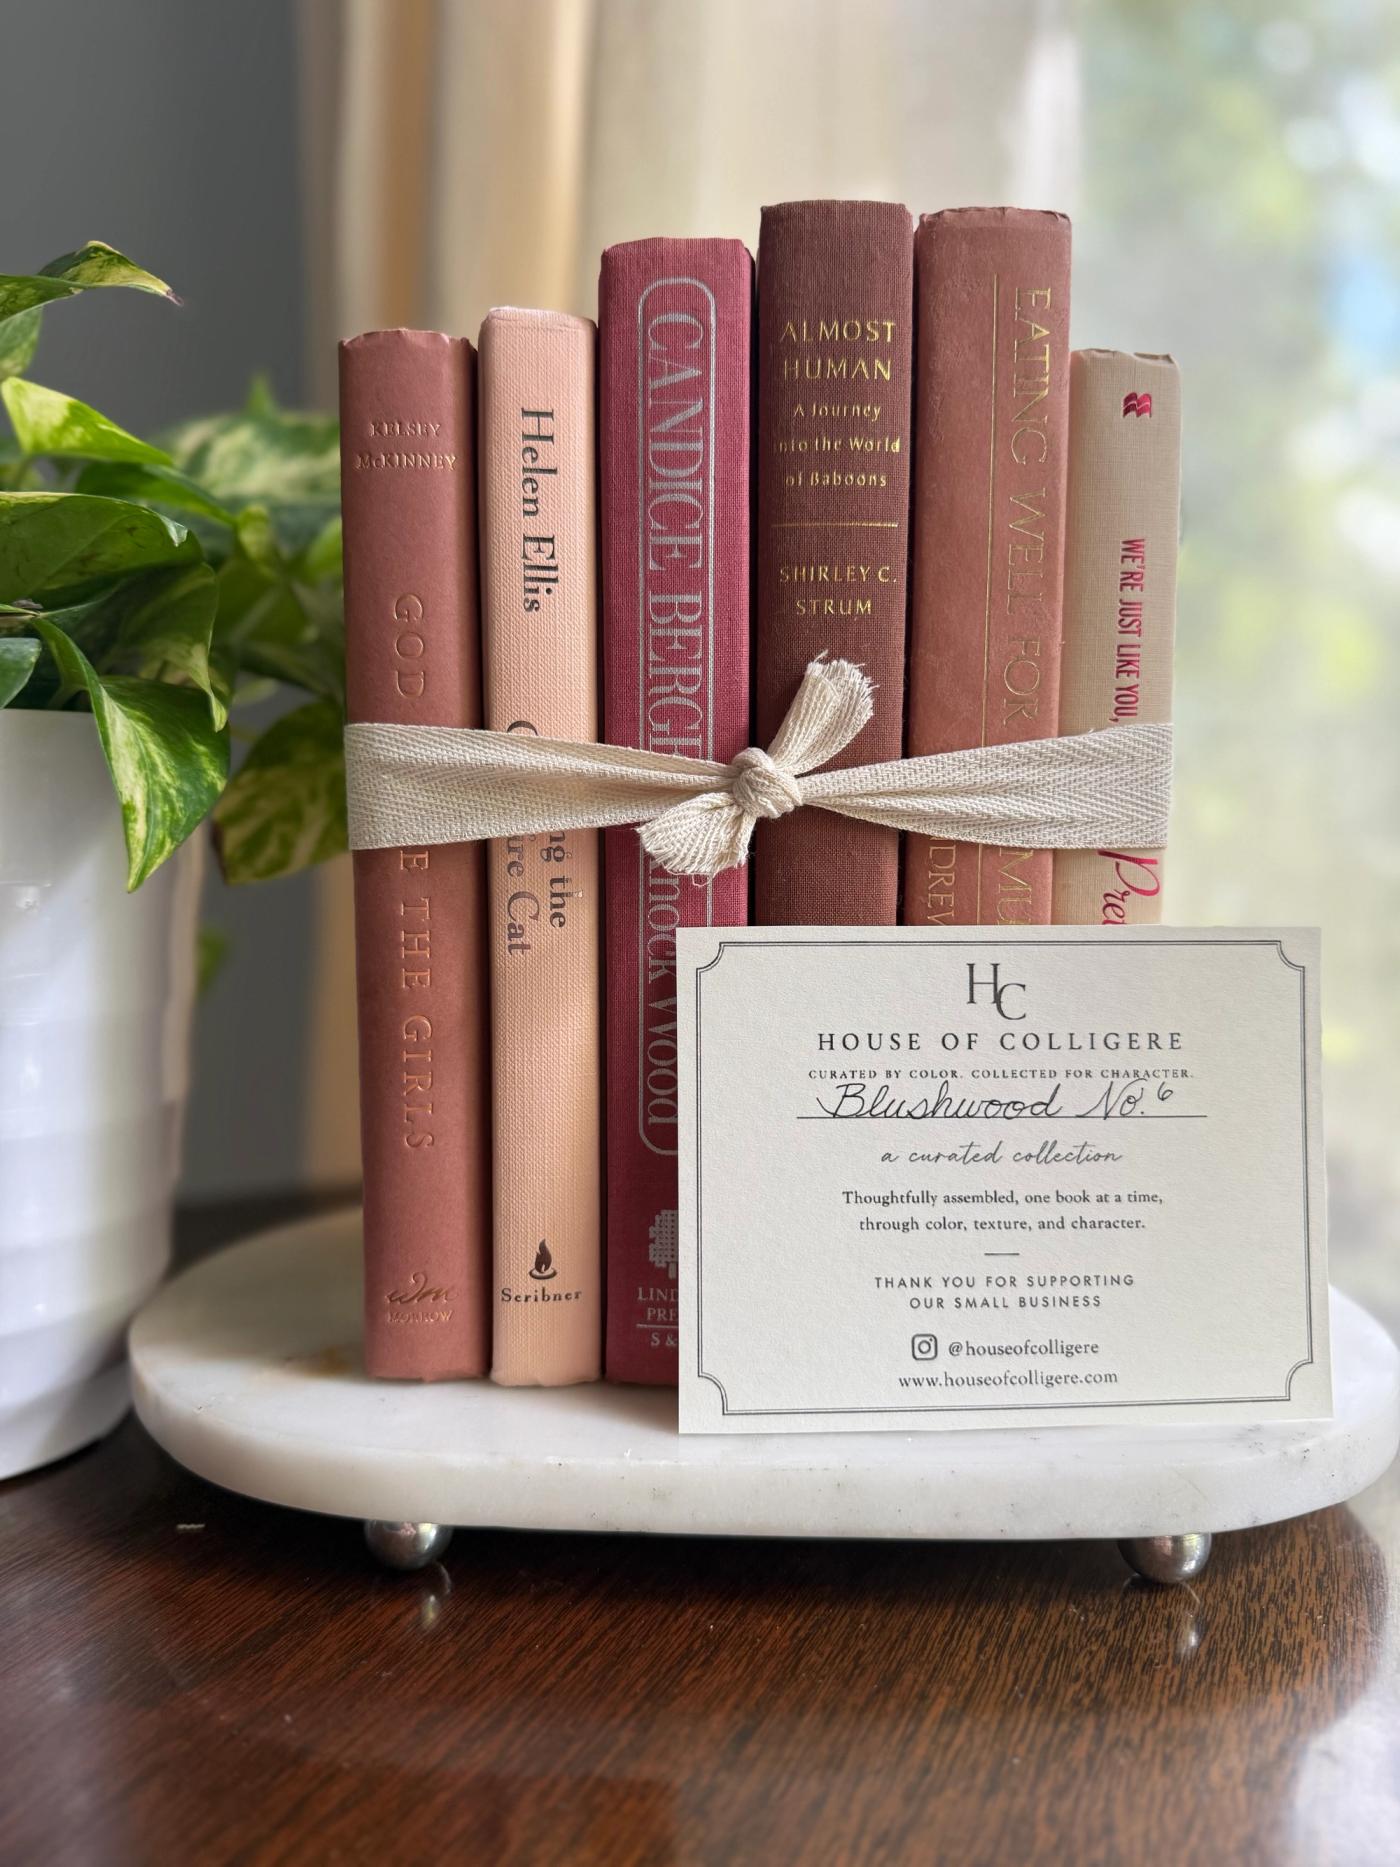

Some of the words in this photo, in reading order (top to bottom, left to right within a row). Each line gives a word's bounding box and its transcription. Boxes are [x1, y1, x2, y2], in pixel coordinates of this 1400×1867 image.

[780, 319, 896, 343] ALMOST
[783, 357, 892, 381] HUMAN
[1009, 286, 1052, 465] EATING
[793, 403, 805, 418] A
[812, 402, 881, 422] Journey
[369, 421, 442, 439] KELSEY
[648, 312, 704, 571] CANDICE
[815, 436, 843, 451] the
[849, 437, 901, 453] World
[352, 453, 457, 472] McKINNEY
[520, 407, 559, 519] Helen
[785, 471, 802, 487] of
[810, 470, 888, 488] Baboons
[1007, 487, 1047, 616] WELL
[520, 533, 560, 613] Ellis
[780, 565, 871, 583] SHIRLEY
[878, 565, 897, 583] C.
[1119, 538, 1146, 593] WE'RE
[796, 599, 872, 616] STRUM
[1117, 597, 1143, 638] JUST
[391, 593, 425, 699] GOD
[1115, 644, 1141, 680] LIKE
[648, 590, 703, 761] BERGE
[1003, 634, 1042, 726] FOR
[549, 874, 582, 929] the
[506, 890, 541, 956] Cat
[400, 896, 431, 990] THE
[817, 1032, 921, 1052] HOUSE
[940, 1032, 979, 1052] OF
[999, 1032, 1182, 1052] COLLIGERE
[402, 1014, 434, 1150] GIRLS
[807, 1069, 878, 1080] CURATED
[885, 1069, 902, 1080] BY
[908, 1068, 964, 1082] COLOR.
[970, 1068, 1058, 1080] COLLECTED
[1064, 1068, 1093, 1079] FOR
[1100, 1068, 1194, 1080] CHARACTER.
[816, 1080, 1063, 1120] Blushwood
[1157, 1081, 1174, 1101] 6
[880, 1151, 900, 1163] a
[908, 1139, 1004, 1166] curated
[1012, 1139, 1123, 1166] collection
[841, 1189, 939, 1209] Thoughtfully
[942, 1189, 1020, 1206] assembled,
[1024, 1194, 1051, 1204] one
[1055, 1188, 1091, 1204] book
[1095, 1192, 1111, 1204] at
[1113, 1194, 1123, 1204] a
[1127, 1190, 1163, 1205] time,
[859, 1215, 920, 1234] through
[925, 1215, 968, 1232] color,
[973, 1219, 1033, 1232] texture,
[1037, 1215, 1066, 1231] and
[1070, 1215, 1146, 1230] character.
[874, 1276, 933, 1289] THANK
[941, 1275, 976, 1289] YOU
[985, 1275, 1017, 1289] FOR
[1026, 1274, 1134, 1289] SUPPORTING
[500, 1287, 582, 1303] Scribner
[909, 1296, 945, 1310] OUR
[954, 1296, 1009, 1310] SMALL
[1018, 1295, 1101, 1309] BUSINESS
[647, 1307, 678, 1321] PRE
[948, 1338, 1100, 1359] @houseofcolligere
[898, 1369, 1118, 1389] www.houseofcolligere.com
